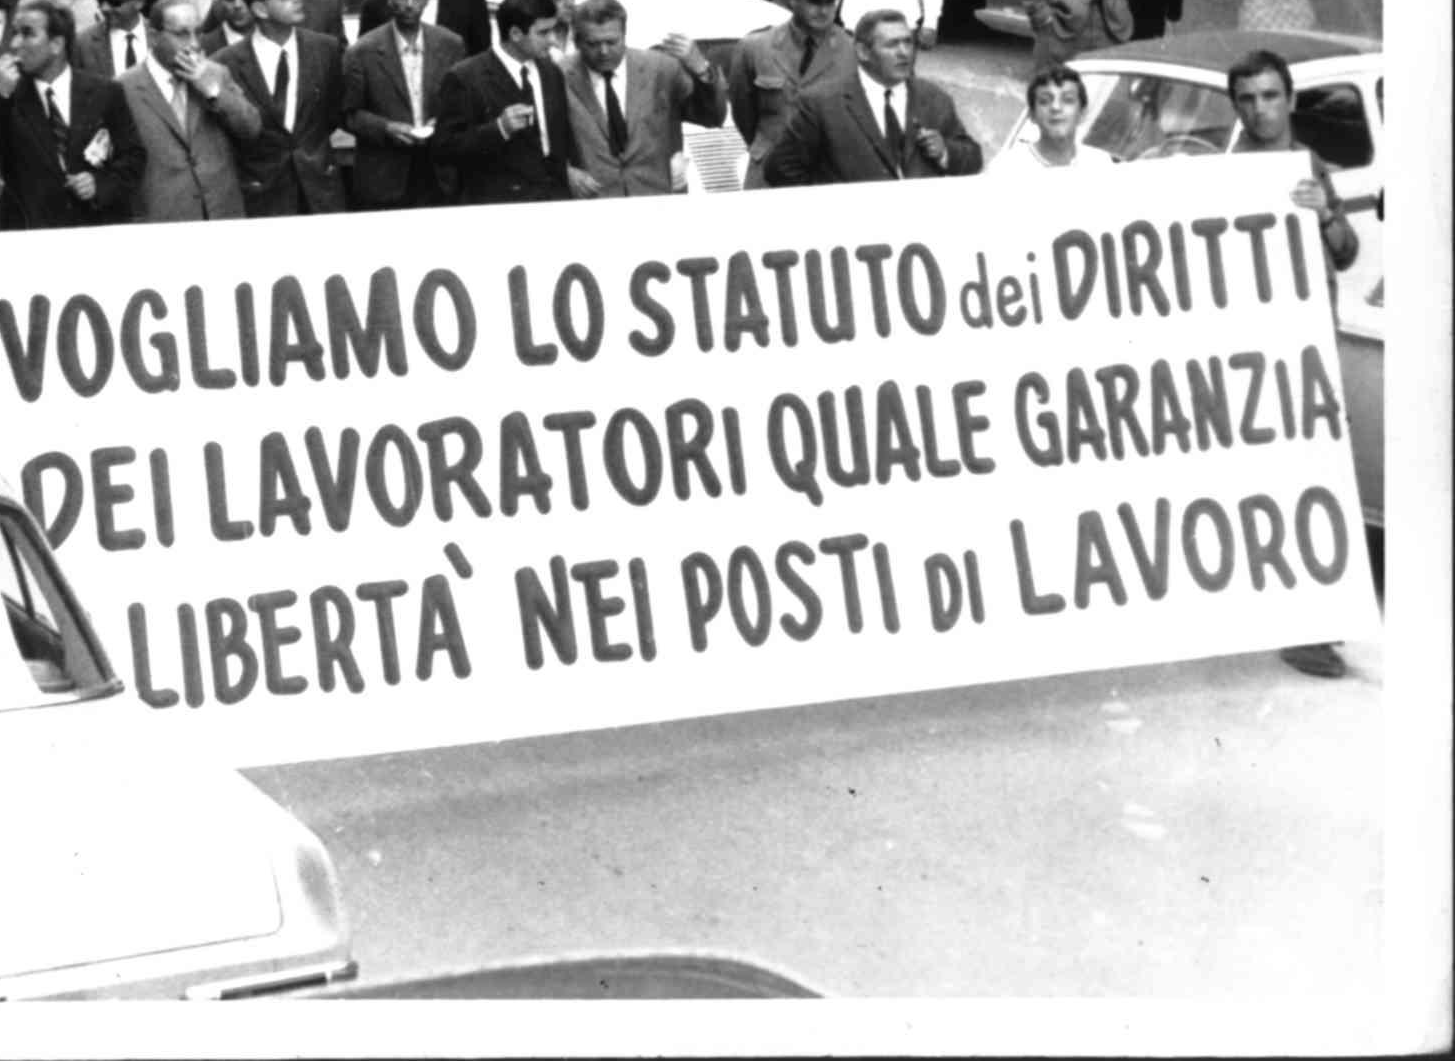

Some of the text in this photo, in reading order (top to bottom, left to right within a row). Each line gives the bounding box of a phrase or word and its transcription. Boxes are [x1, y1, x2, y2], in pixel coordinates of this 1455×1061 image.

[507, 263, 605, 366] LO
[627, 242, 947, 357] STATUTO
[959, 251, 1043, 330] dei
[1051, 213, 1310, 320] DIRITTI
[21, 346, 1342, 552] DEI LAVORATORI QUALE GARANZIA
[127, 486, 1348, 709] LIBERTÀ NEI POSTI DI LAVORO
